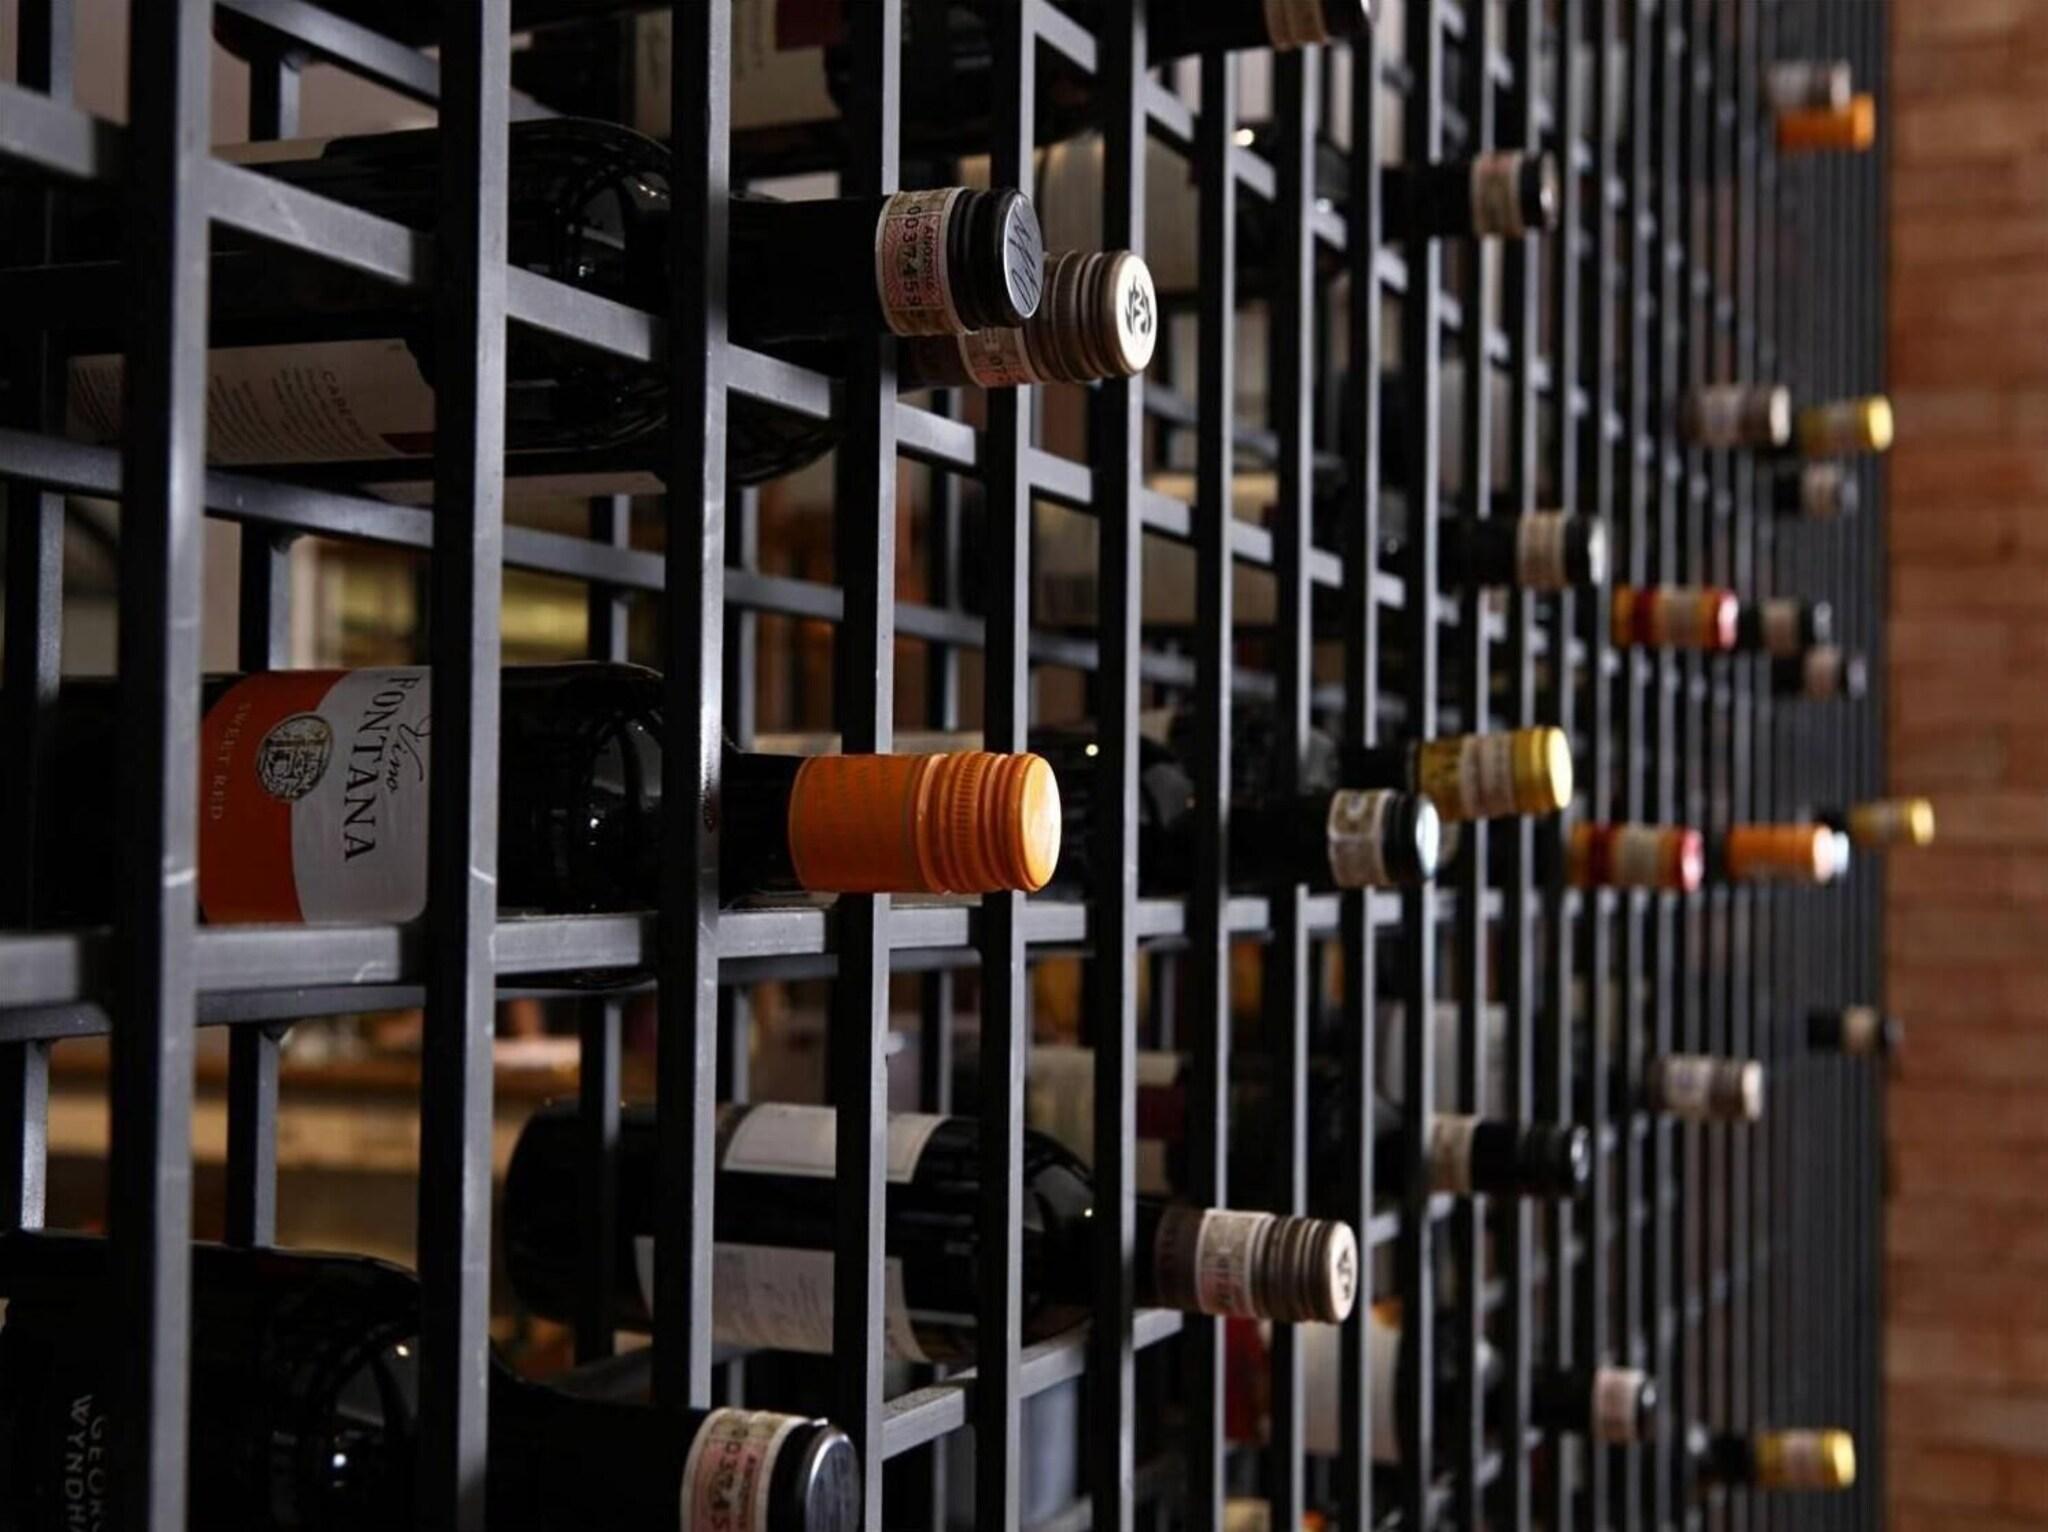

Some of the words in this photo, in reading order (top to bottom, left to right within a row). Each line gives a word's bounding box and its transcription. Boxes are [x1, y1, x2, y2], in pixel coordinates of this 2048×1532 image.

[215, 701, 252, 768] SWEET
[343, 676, 421, 862] FONTANA
[387, 714, 434, 795] Vino
[211, 773, 228, 820] RED
